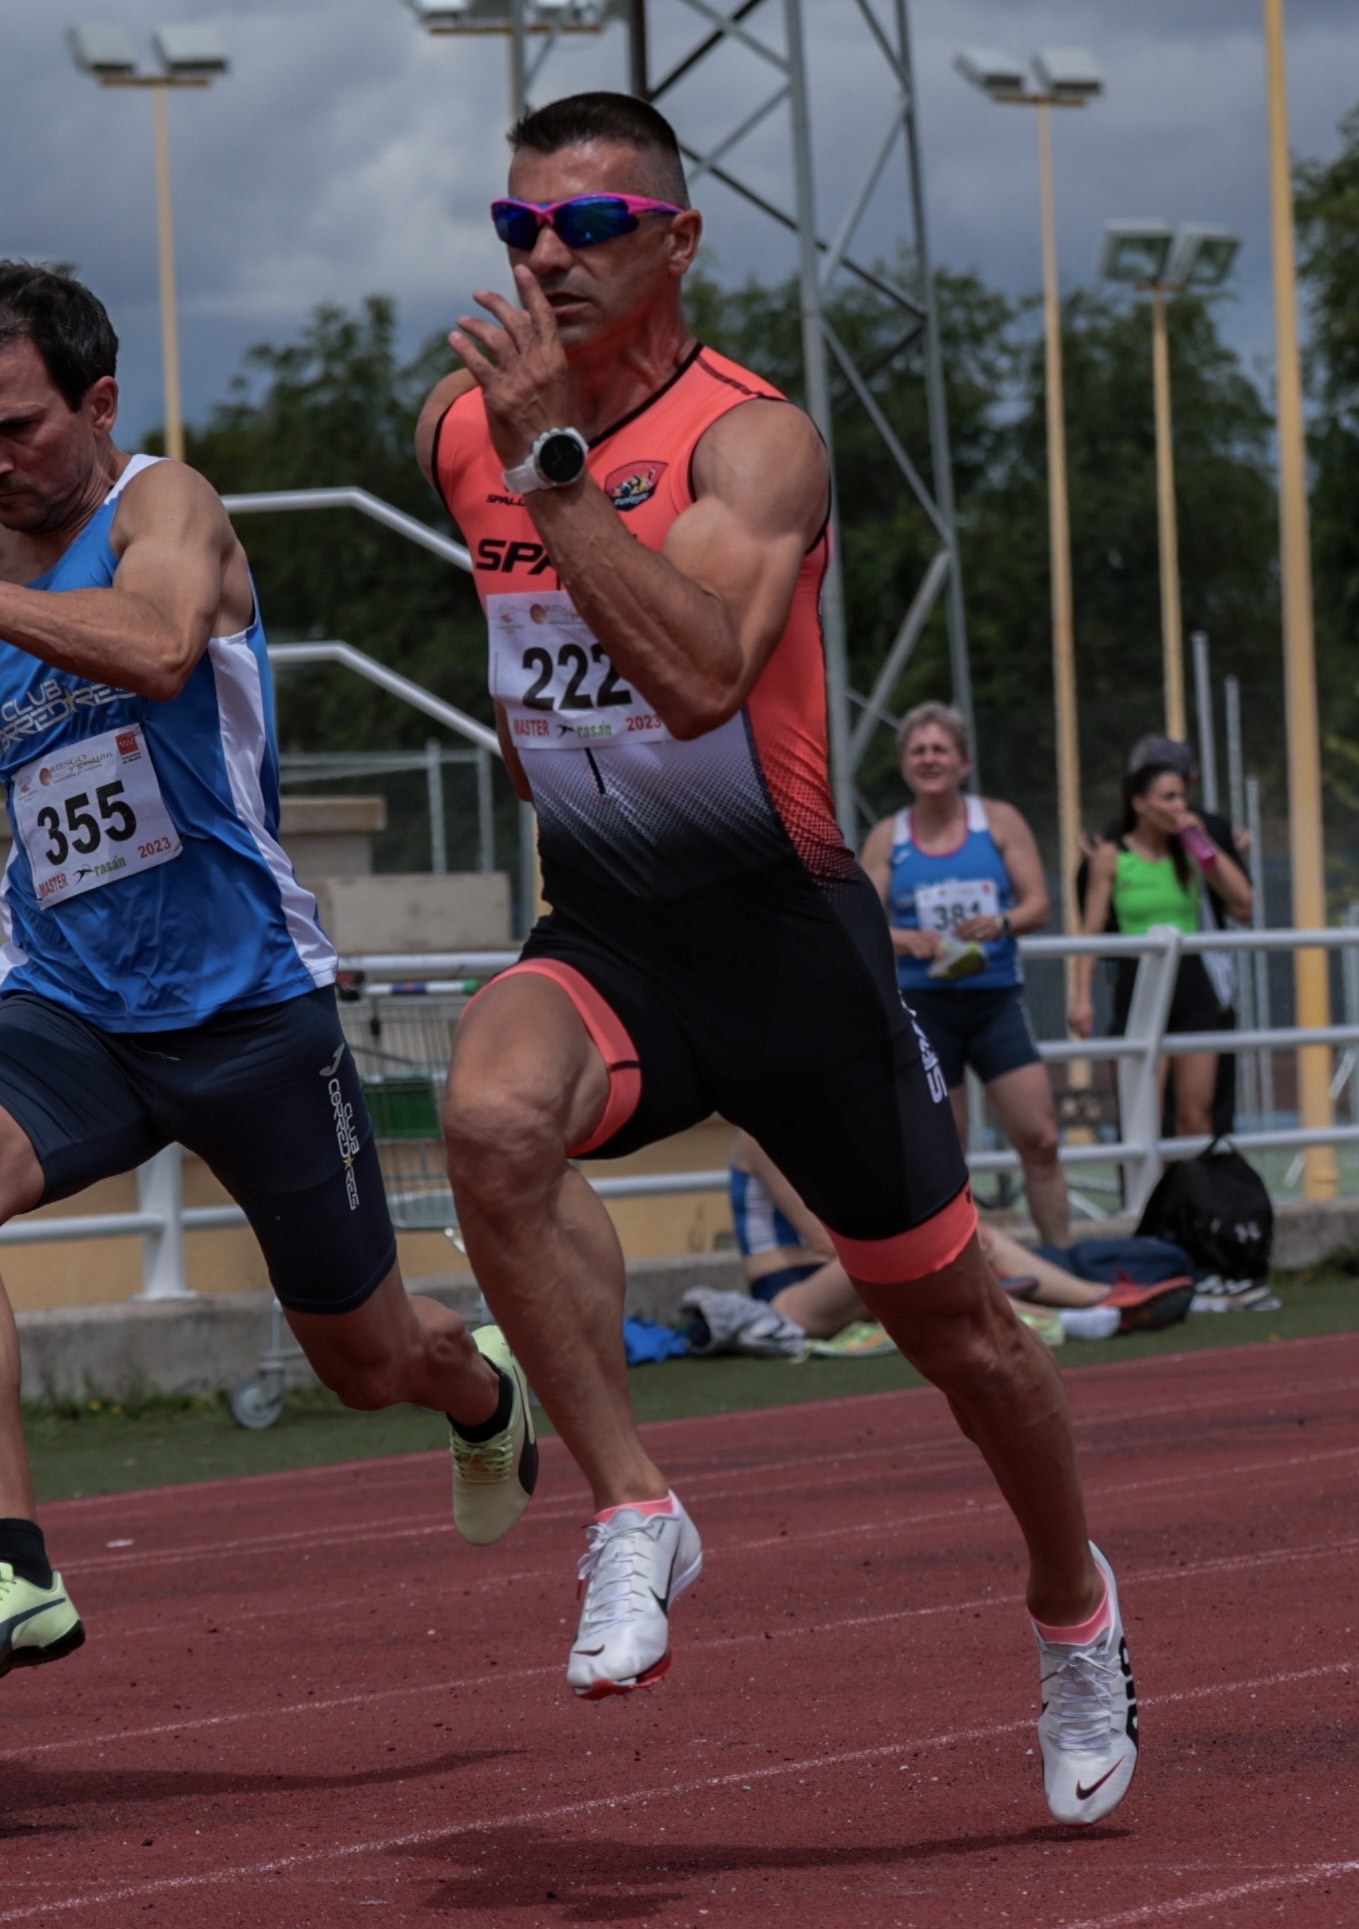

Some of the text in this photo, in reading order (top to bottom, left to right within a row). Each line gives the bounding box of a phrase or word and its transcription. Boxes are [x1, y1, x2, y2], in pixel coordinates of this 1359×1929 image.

[522, 643, 633, 711] 222
[2, 679, 62, 722] CLUB
[513, 718, 550, 737] MASTER
[625, 714, 662, 732] 2023
[37, 780, 137, 866] 355
[137, 836, 172, 859] 2023
[38, 873, 69, 897] MASTER
[344, 1102, 360, 1155] CLUB
